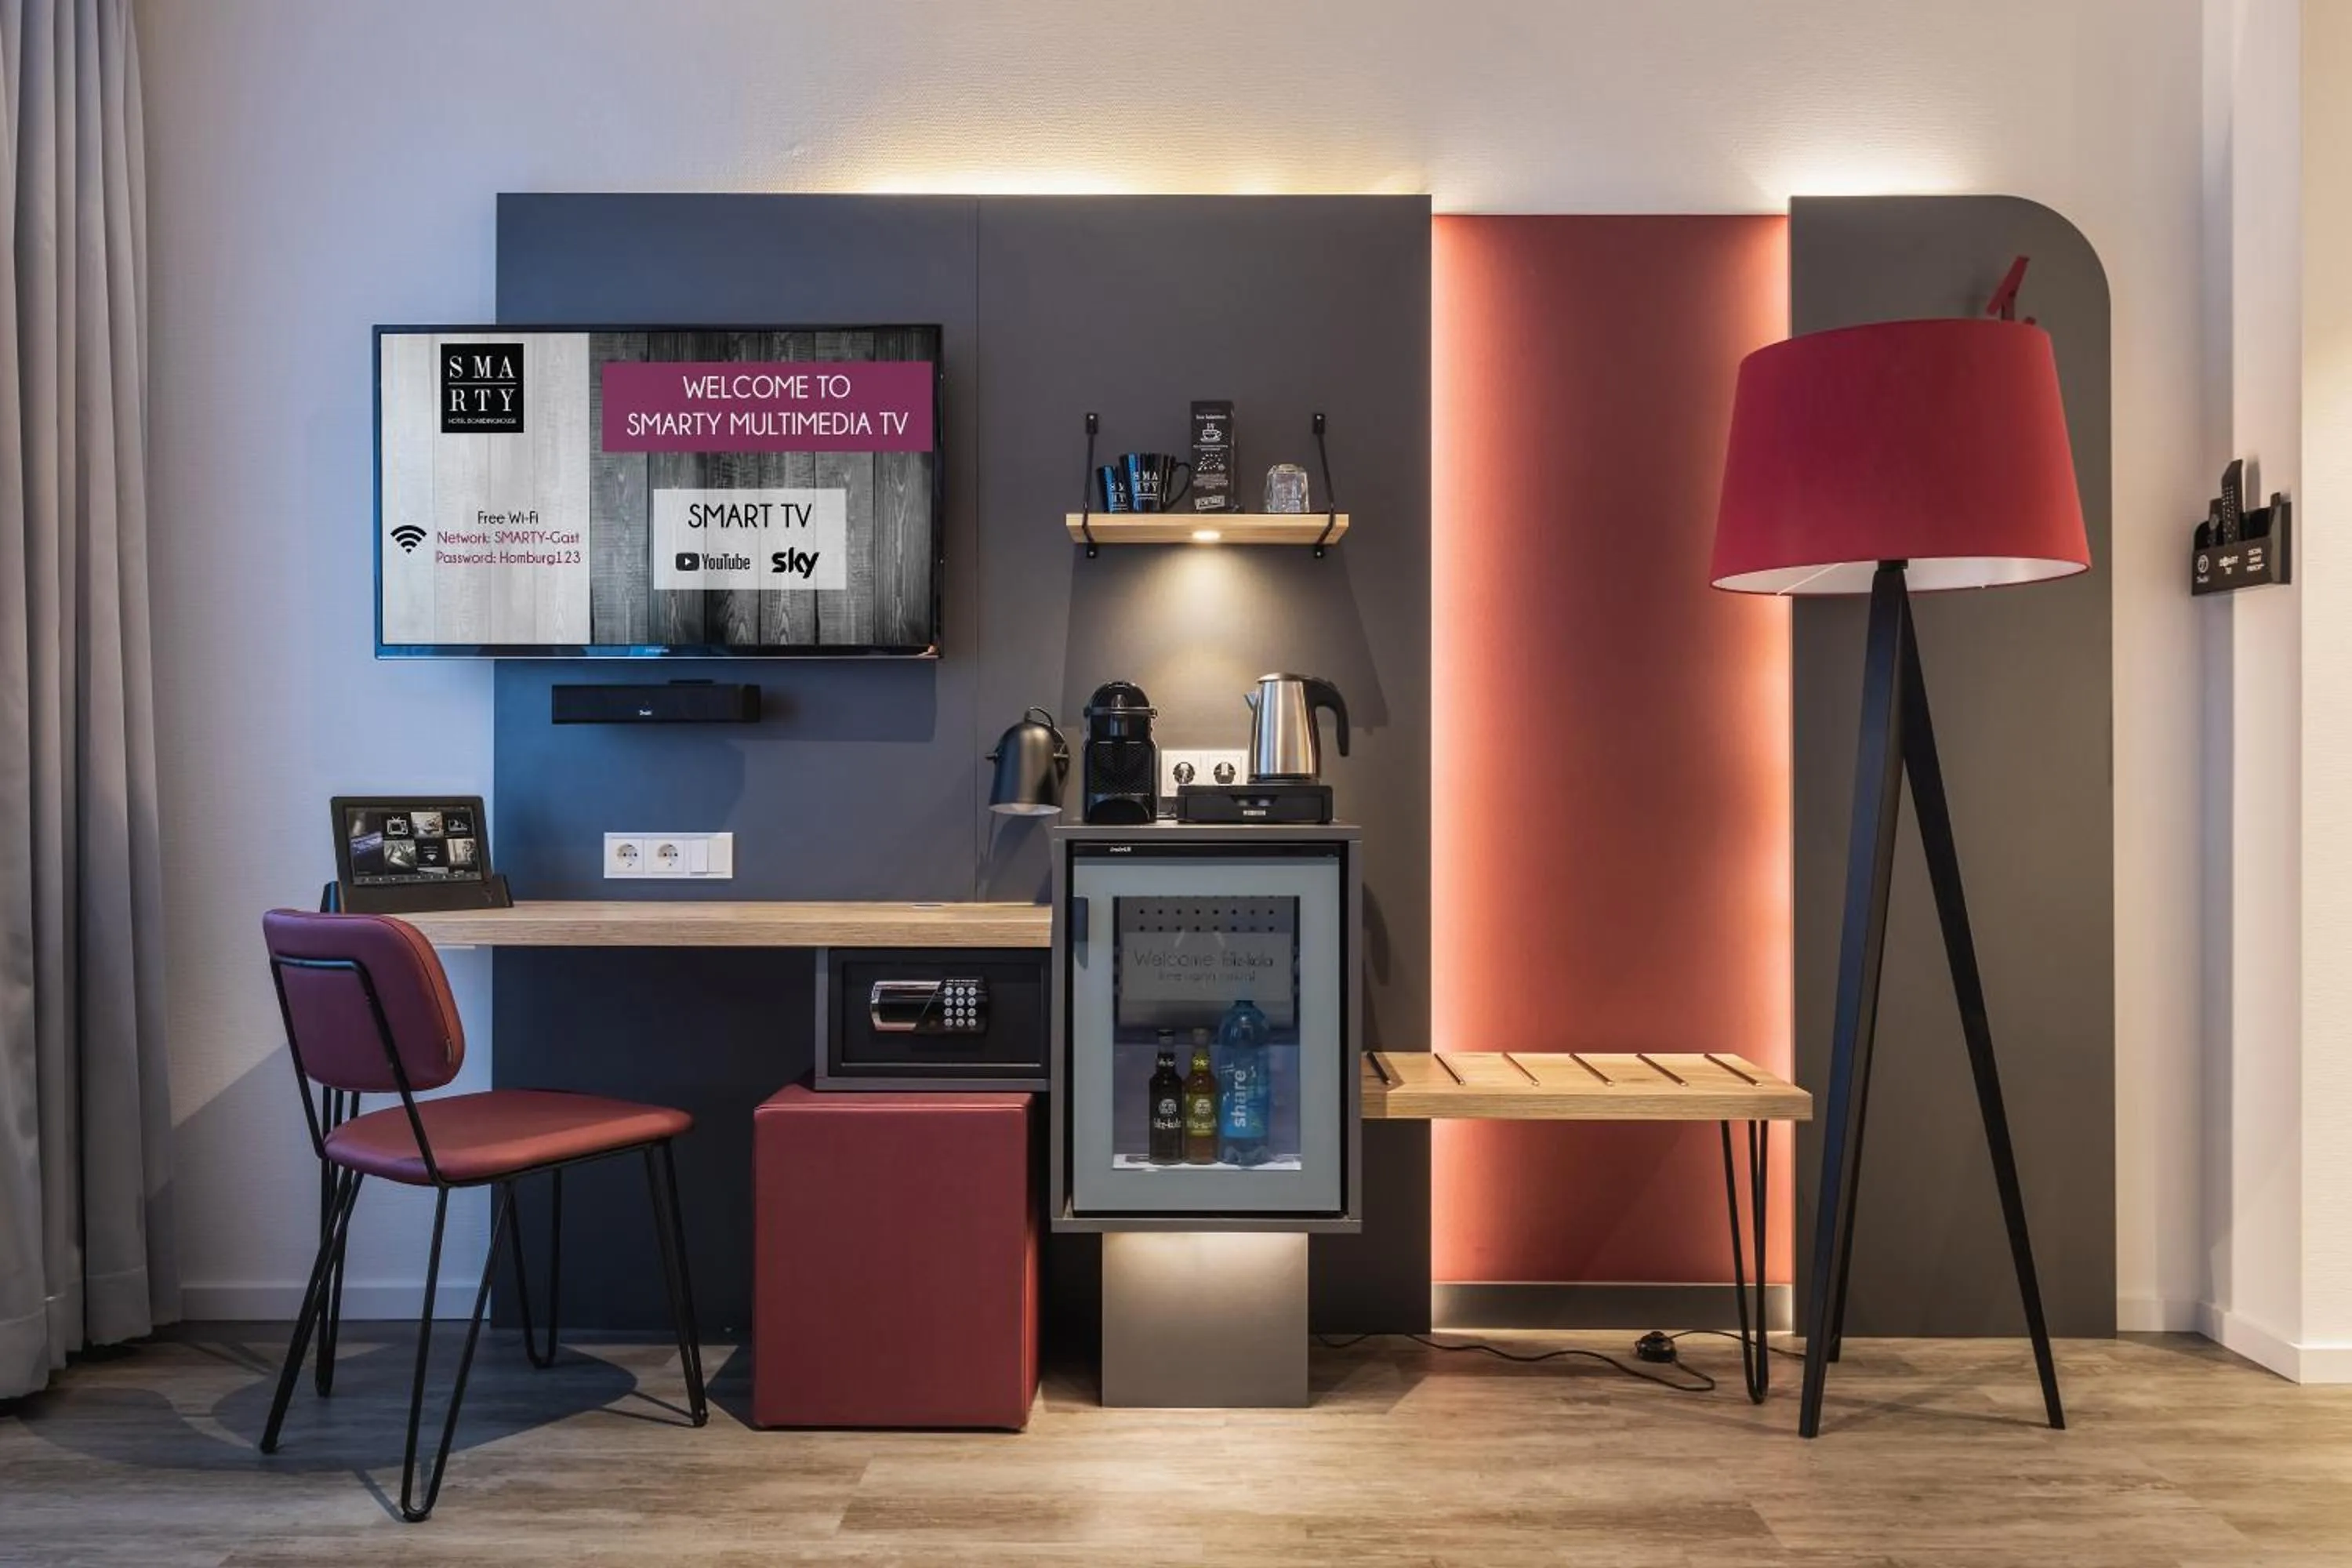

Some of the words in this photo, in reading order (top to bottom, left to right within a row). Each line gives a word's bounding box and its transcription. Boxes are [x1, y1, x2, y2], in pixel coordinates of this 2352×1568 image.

[683, 375, 808, 399] WELCOME
[817, 375, 851, 399] TO
[626, 412, 722, 436] SMARTY
[730, 412, 872, 436] MULTIMEDIA
[879, 412, 909, 436] TV
[477, 510, 505, 524] Free
[509, 510, 539, 524] Wi-Fi
[688, 503, 773, 528] SMART
[780, 503, 812, 528] TV
[437, 531, 491, 543] Network:
[495, 530, 580, 544] SMARTY-Gast
[435, 550, 496, 564] Password:
[499, 550, 581, 565] Homburg123
[702, 553, 750, 570] YouTube
[771, 546, 820, 579] sky
[1134, 948, 1214, 967] Welcome
[1230, 1069, 1247, 1128] share
